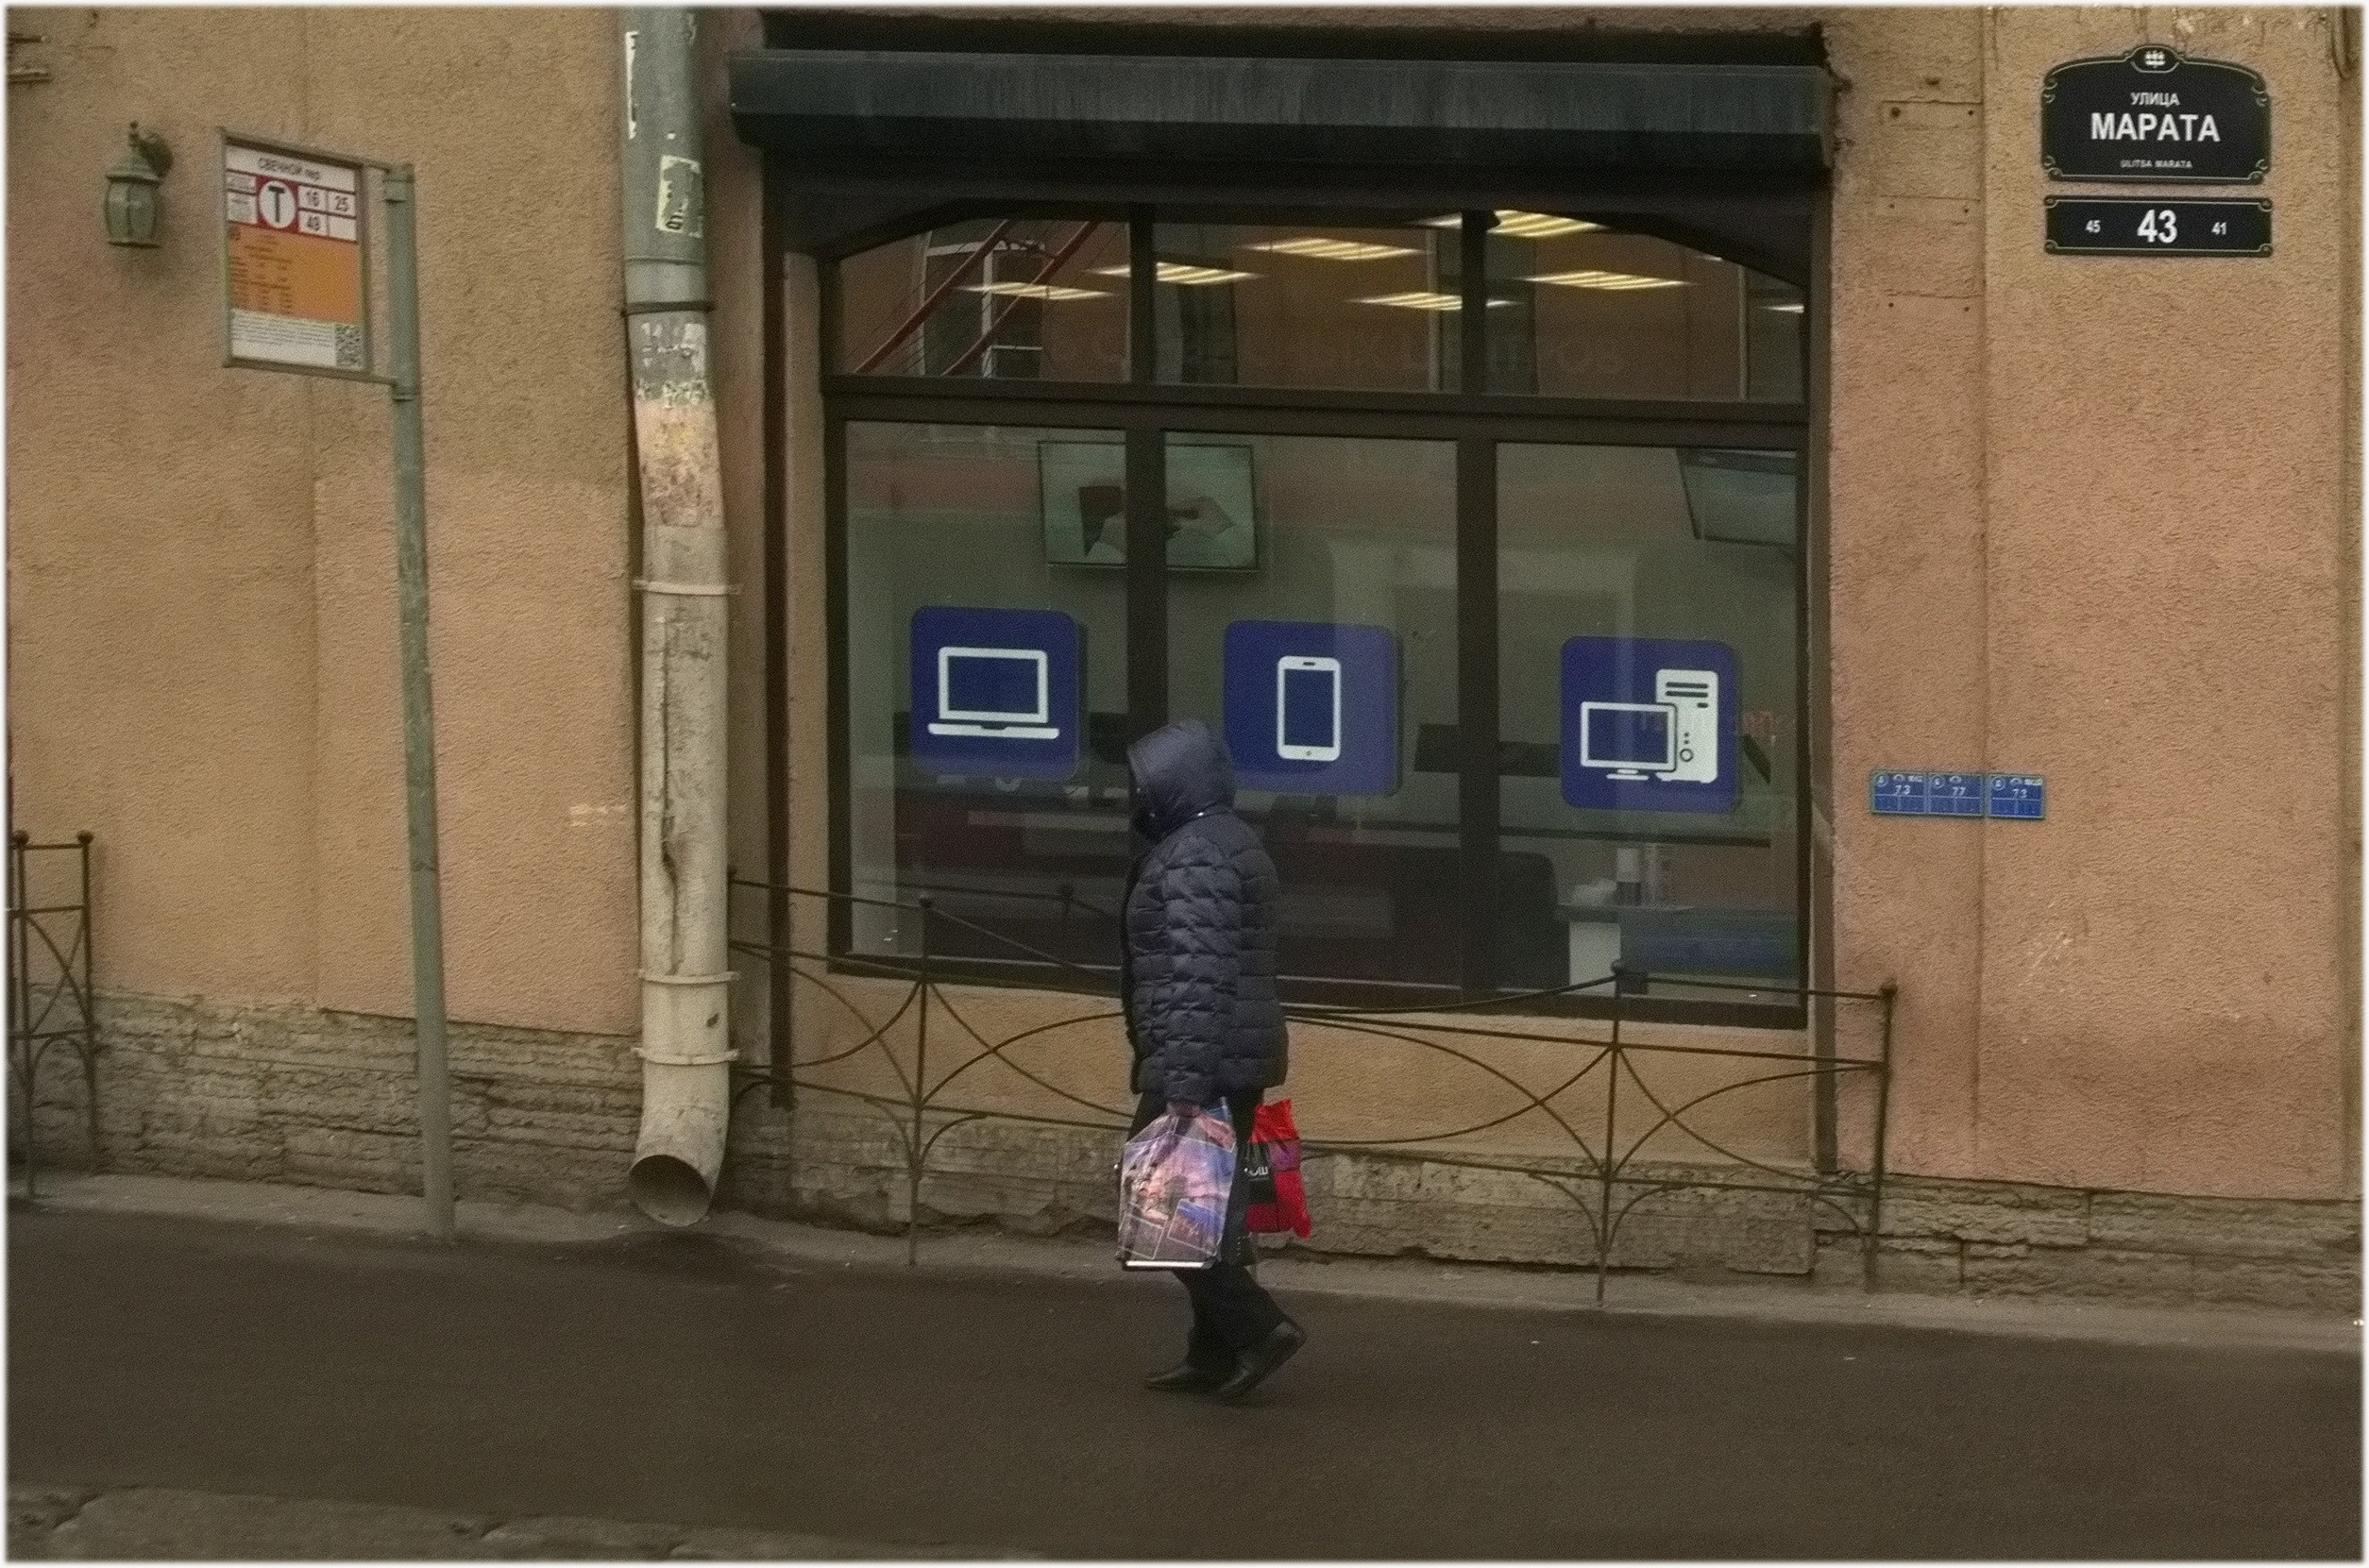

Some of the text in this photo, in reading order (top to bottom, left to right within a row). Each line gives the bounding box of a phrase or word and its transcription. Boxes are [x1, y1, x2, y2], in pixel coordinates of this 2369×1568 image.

[2130, 92, 2180, 108] УЛИЦА
[2090, 112, 2221, 143] МАРАТА
[2155, 160, 2192, 169] MARATA
[334, 195, 349, 212] 25
[2085, 219, 2102, 234] 45
[2137, 209, 2178, 244] 43
[2211, 222, 2227, 236] 41
